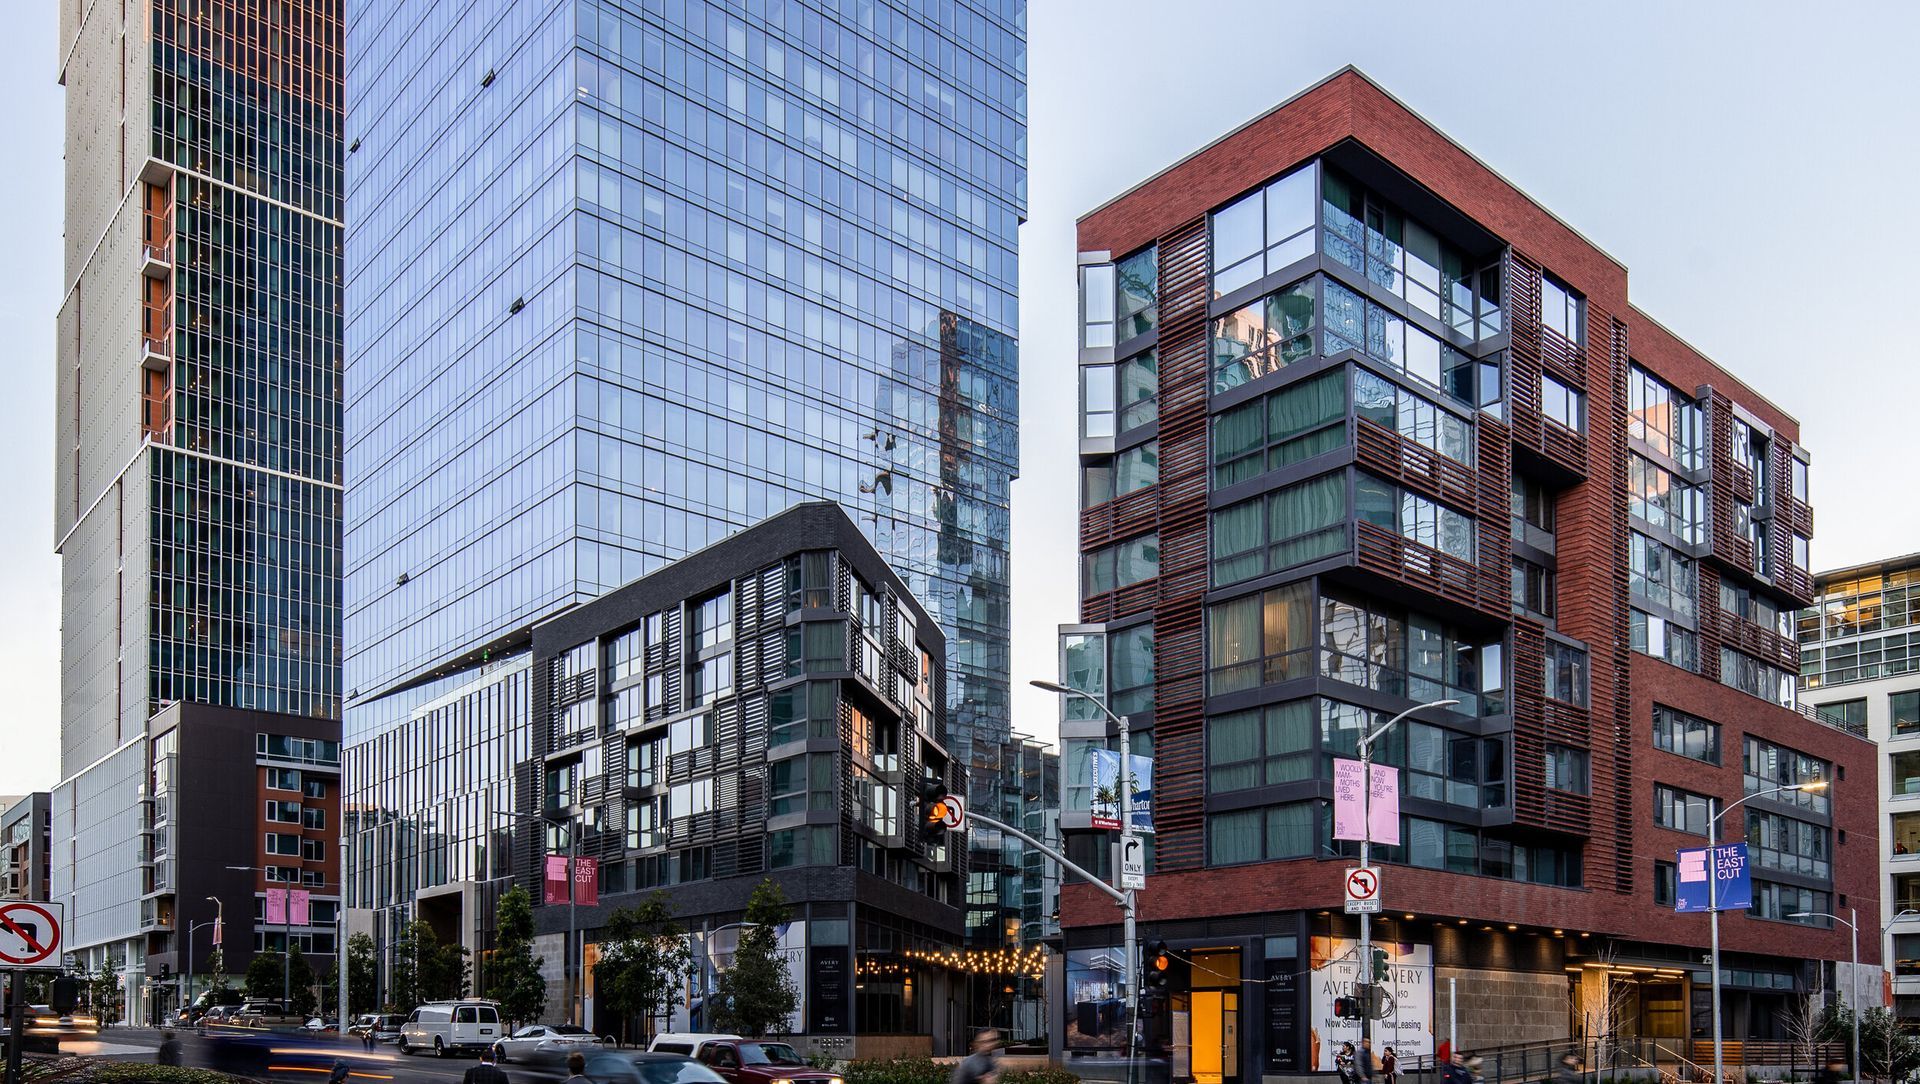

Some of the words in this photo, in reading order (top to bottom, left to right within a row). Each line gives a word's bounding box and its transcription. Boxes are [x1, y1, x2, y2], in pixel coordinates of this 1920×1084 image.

[1340, 764, 1362, 772] WOOLLY
[1336, 771, 1352, 779] MAM-
[1374, 769, 1386, 778] AND
[1340, 779, 1361, 788] MOTHS
[1371, 776, 1384, 784] NOW
[1374, 784, 1393, 793] YOU'RE
[1131, 798, 1150, 811] harto
[1716, 846, 1738, 858] THE
[576, 859, 591, 867] THE
[1717, 856, 1745, 869] EAST
[575, 867, 595, 875] EAST
[1125, 863, 1141, 872] ONLY
[1717, 868, 1741, 880] CUT
[575, 875, 592, 883] CUT
[1339, 966, 1351, 974] THE
[1391, 969, 1422, 984] VERY
[1325, 1018, 1341, 1028] Now
[1342, 1019, 1361, 1028] Sellin
[1382, 1019, 1396, 1029] Now
